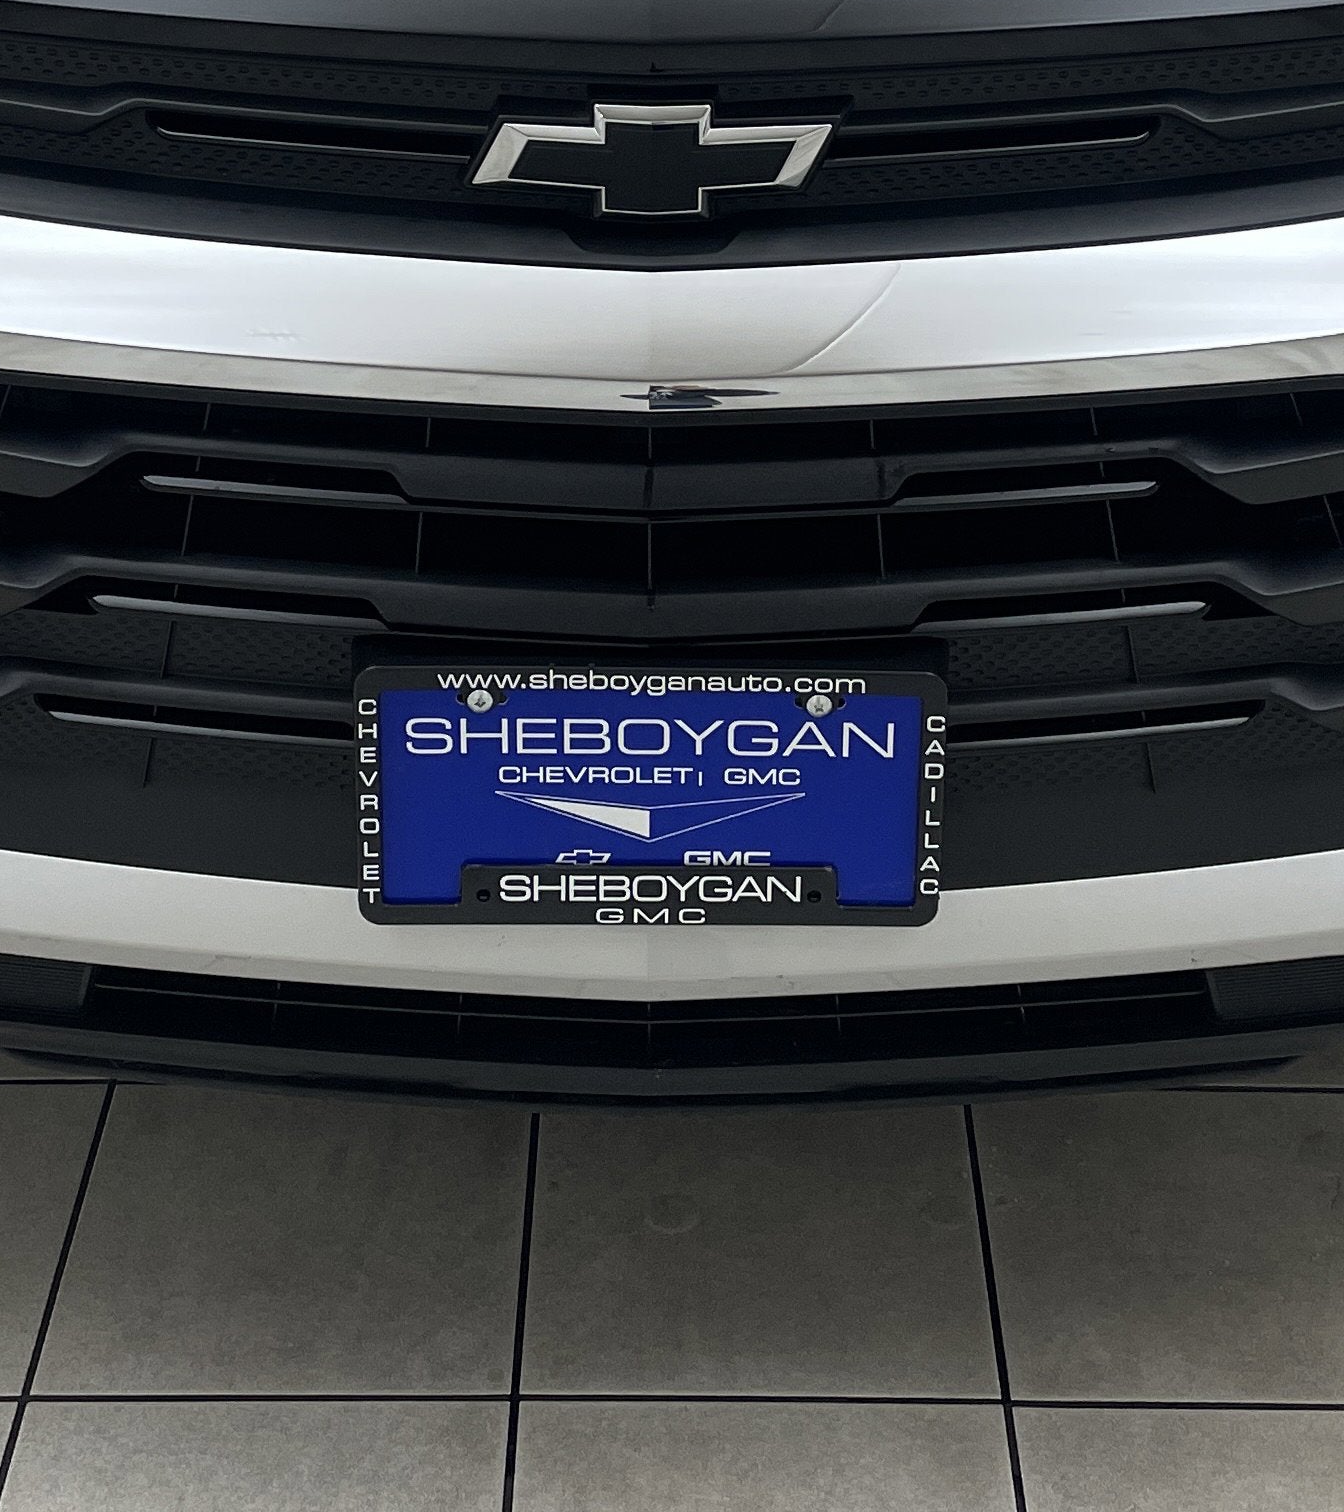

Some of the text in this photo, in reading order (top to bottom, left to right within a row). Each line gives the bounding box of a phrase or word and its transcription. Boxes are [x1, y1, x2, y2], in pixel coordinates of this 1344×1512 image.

[437, 670, 866, 696] www.sheboyganauto.com
[405, 717, 896, 759] SHEBOYGAN
[723, 768, 801, 786] GMC
[358, 698, 381, 905] CHEVROLET
[919, 715, 947, 896] CADILLAC
[683, 850, 771, 867] GMC
[499, 874, 802, 903] SHEBOYGAN
[595, 907, 706, 924] GMC
